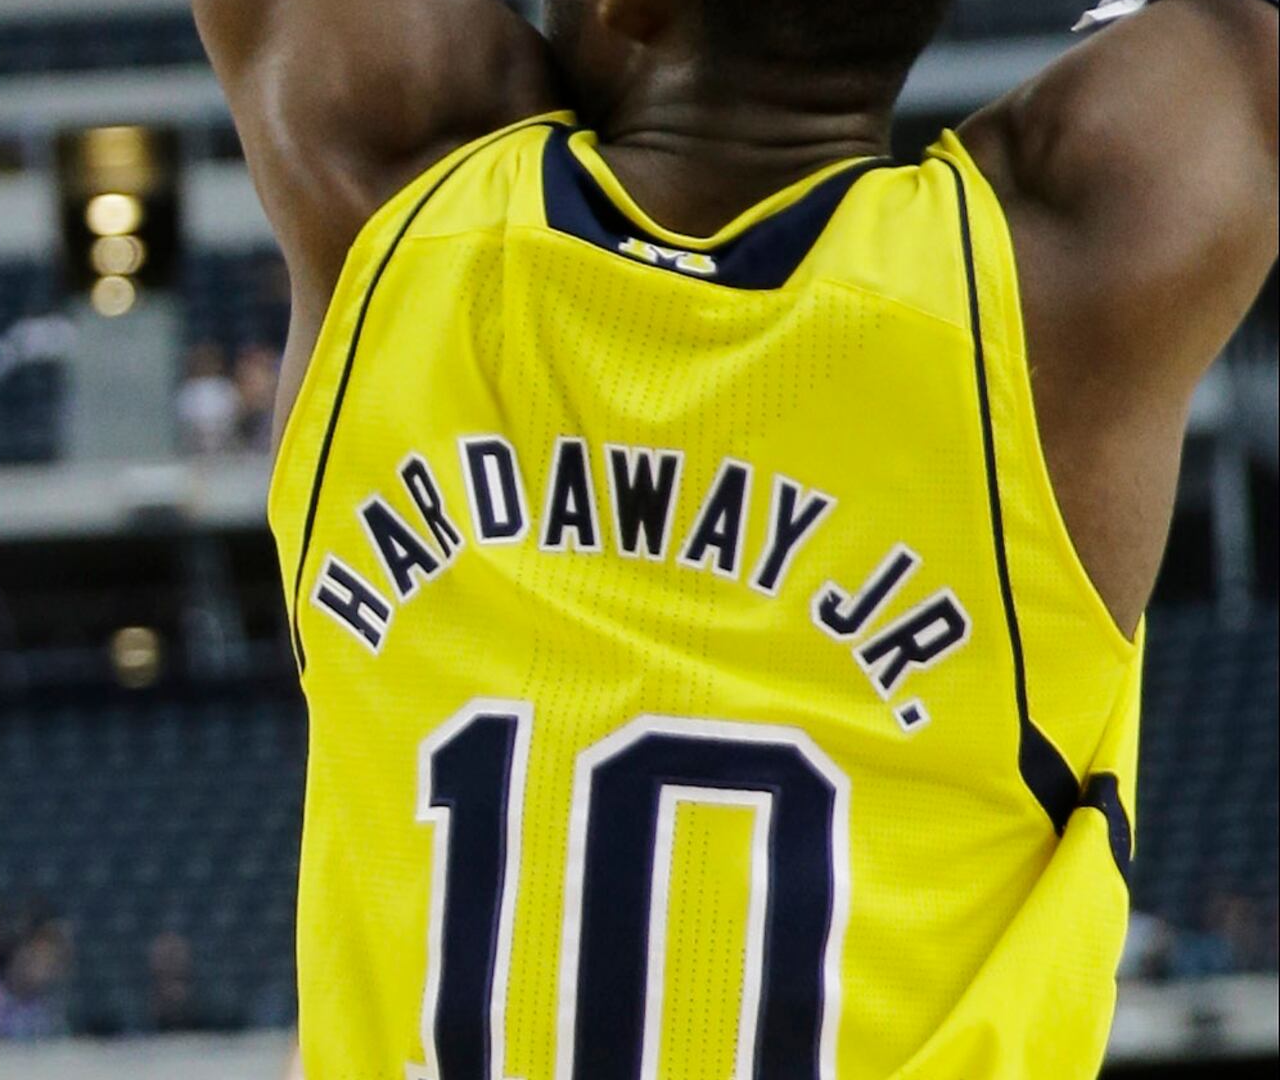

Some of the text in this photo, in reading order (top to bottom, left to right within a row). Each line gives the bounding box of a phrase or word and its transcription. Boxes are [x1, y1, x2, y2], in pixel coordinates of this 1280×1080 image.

[309, 434, 972, 733] HARDAWAY JR.
[404, 696, 852, 1080] 10
